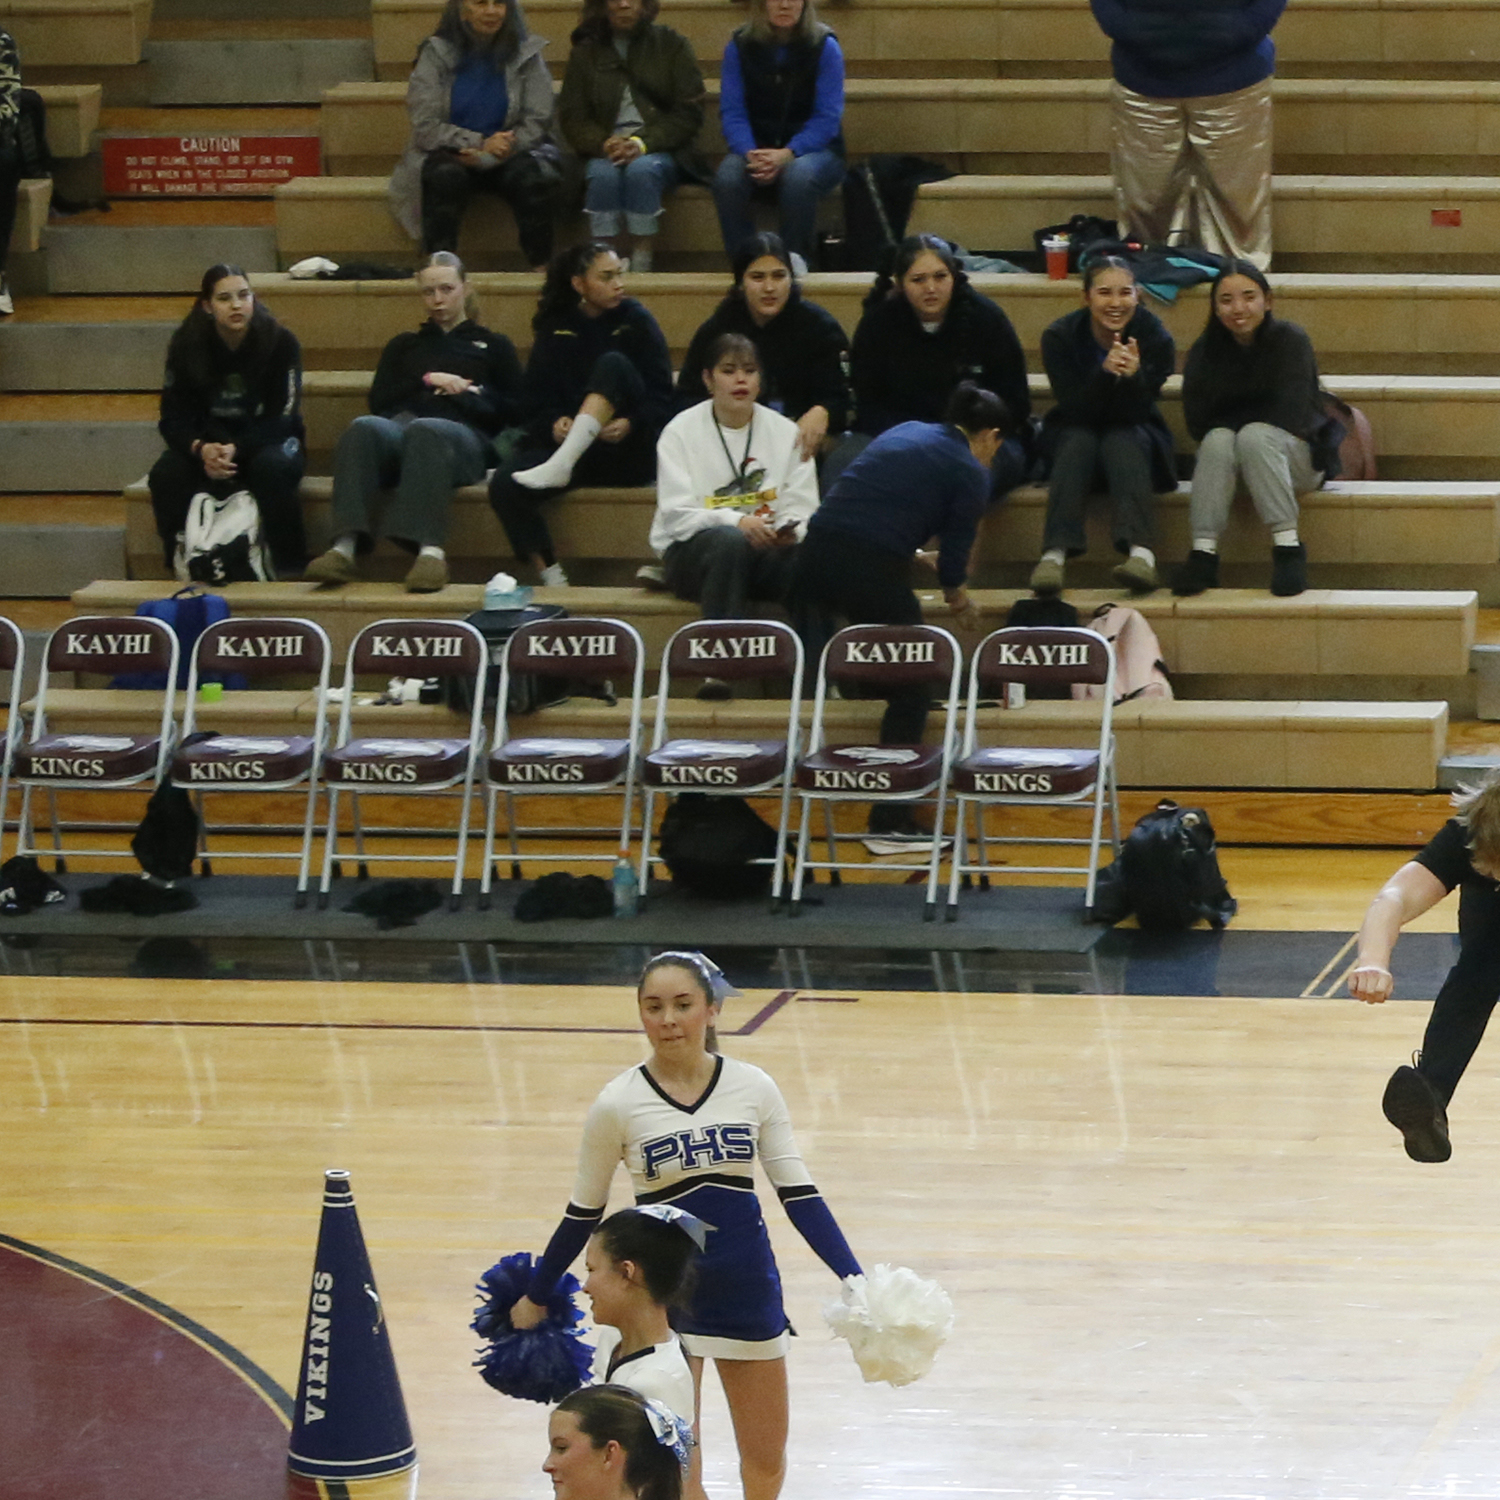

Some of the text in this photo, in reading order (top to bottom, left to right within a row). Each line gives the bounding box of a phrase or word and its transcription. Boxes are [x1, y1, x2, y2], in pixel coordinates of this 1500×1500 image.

[180, 138, 240, 152] CAUTION
[197, 169, 212, 179] THE
[66, 634, 152, 655] KAYHI
[216, 635, 304, 658] KAYHI
[371, 636, 464, 658] KAYHI
[528, 635, 617, 657] KAYHI
[688, 636, 776, 659] KAYHI
[844, 641, 935, 663] KAYHI
[998, 644, 1090, 666] KAYHI
[30, 758, 105, 778] KINGS
[190, 760, 266, 780] KINGS
[341, 763, 418, 782] KINGS
[507, 764, 584, 782] KINGS
[660, 766, 738, 784] KINGS
[814, 770, 891, 790] KINGS
[974, 774, 1052, 793] KINGS
[640, 1123, 757, 1181] PHS
[304, 1271, 334, 1425] VIKINGS
